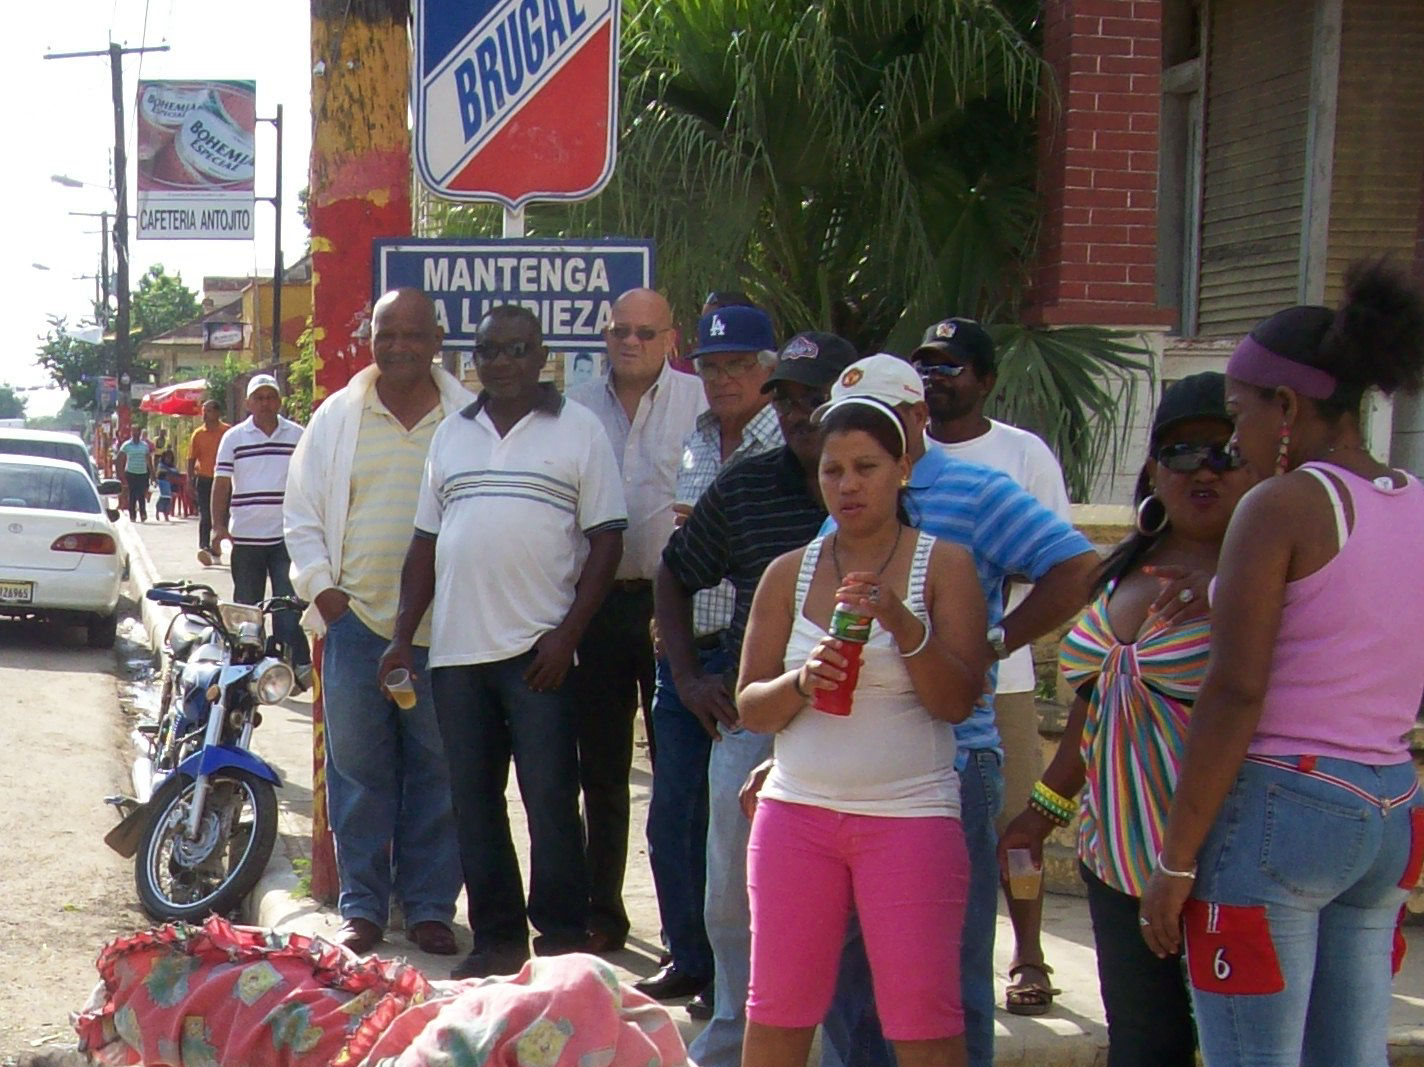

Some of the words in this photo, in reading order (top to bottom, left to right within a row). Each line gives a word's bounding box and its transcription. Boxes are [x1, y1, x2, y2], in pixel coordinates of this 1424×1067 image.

[454, 0, 587, 145] BRUGAL
[190, 139, 240, 171] ESPECIAL
[140, 210, 196, 230] CAFETERIA
[200, 210, 250, 231] ANTOJITO
[424, 257, 610, 292] MANTENGA
[435, 300, 450, 334] A
[461, 298, 612, 335] LIEZA
[710, 314, 726, 336] LA
[1214, 948, 1231, 980] 6
